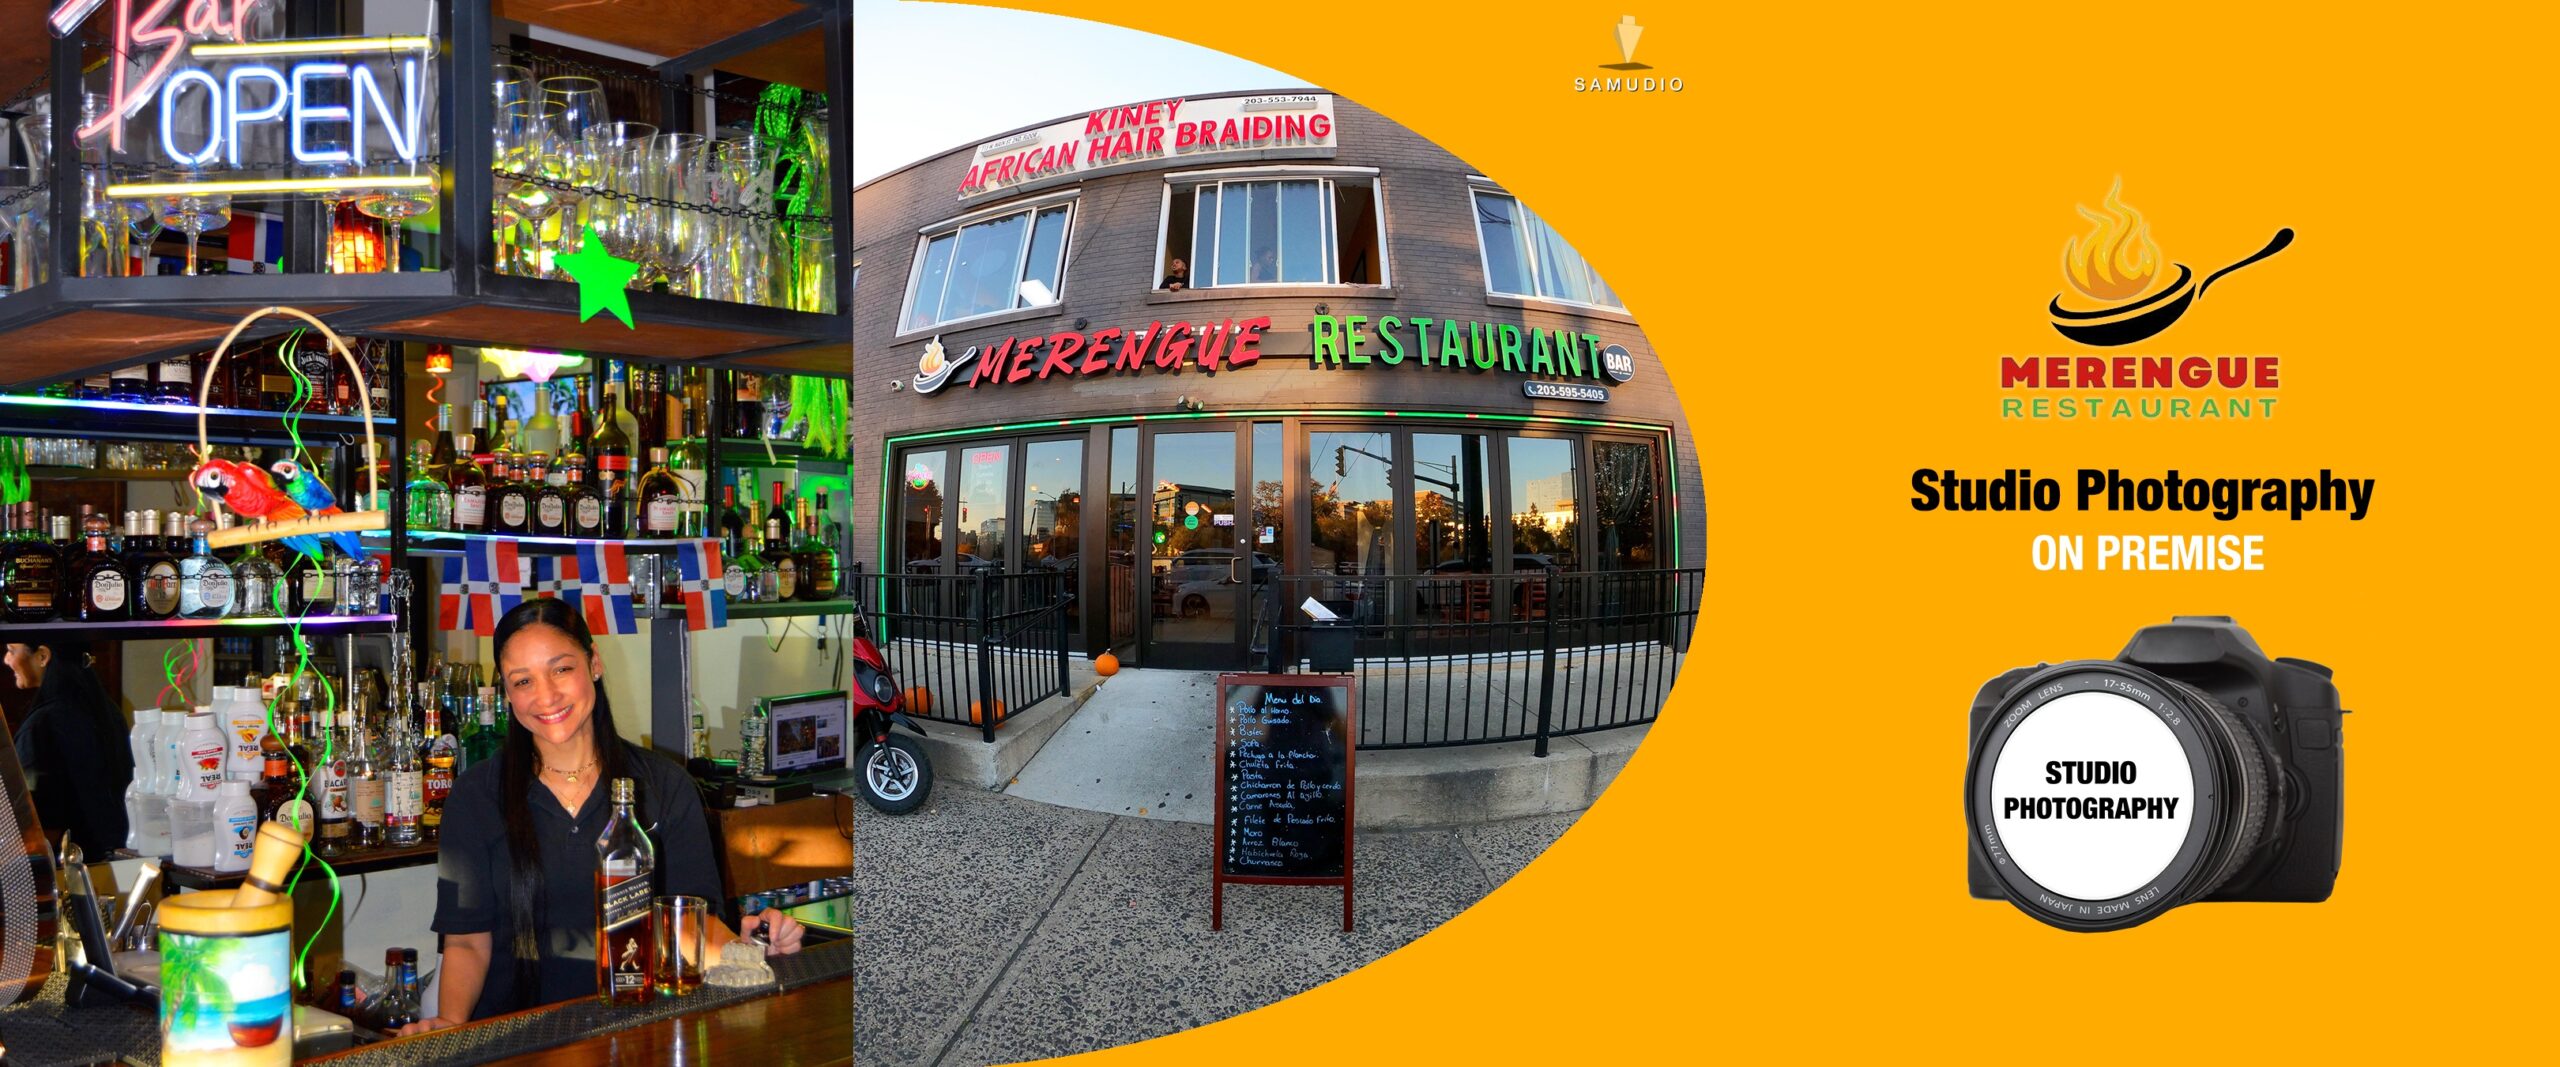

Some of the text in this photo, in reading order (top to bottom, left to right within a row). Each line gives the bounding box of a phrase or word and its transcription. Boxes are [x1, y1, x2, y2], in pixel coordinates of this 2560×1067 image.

[1244, 96, 1316, 104] 203-553-7944
[160, 60, 417, 165] OPEN
[1085, 98, 1184, 136] KINEY
[958, 113, 1331, 192] AFRICAN HAIR BRAIDING
[969, 315, 1600, 389] MERENGUE RESTAURANT
[1606, 353, 1632, 372] BAR
[1537, 384, 1605, 400] 203-595-5405
[1292, 693, 1304, 704] del
[2003, 699, 2033, 728] ZOOM
[2037, 682, 2064, 701] LENS
[2103, 678, 2151, 702] 17-55mm
[2157, 702, 2181, 726] 1:2.8
[1287, 780, 1295, 789] de
[603, 896, 628, 909] BLACK
[2039, 886, 2160, 915] LENS MADE IN JAPAN
[625, 976, 634, 984] 12
